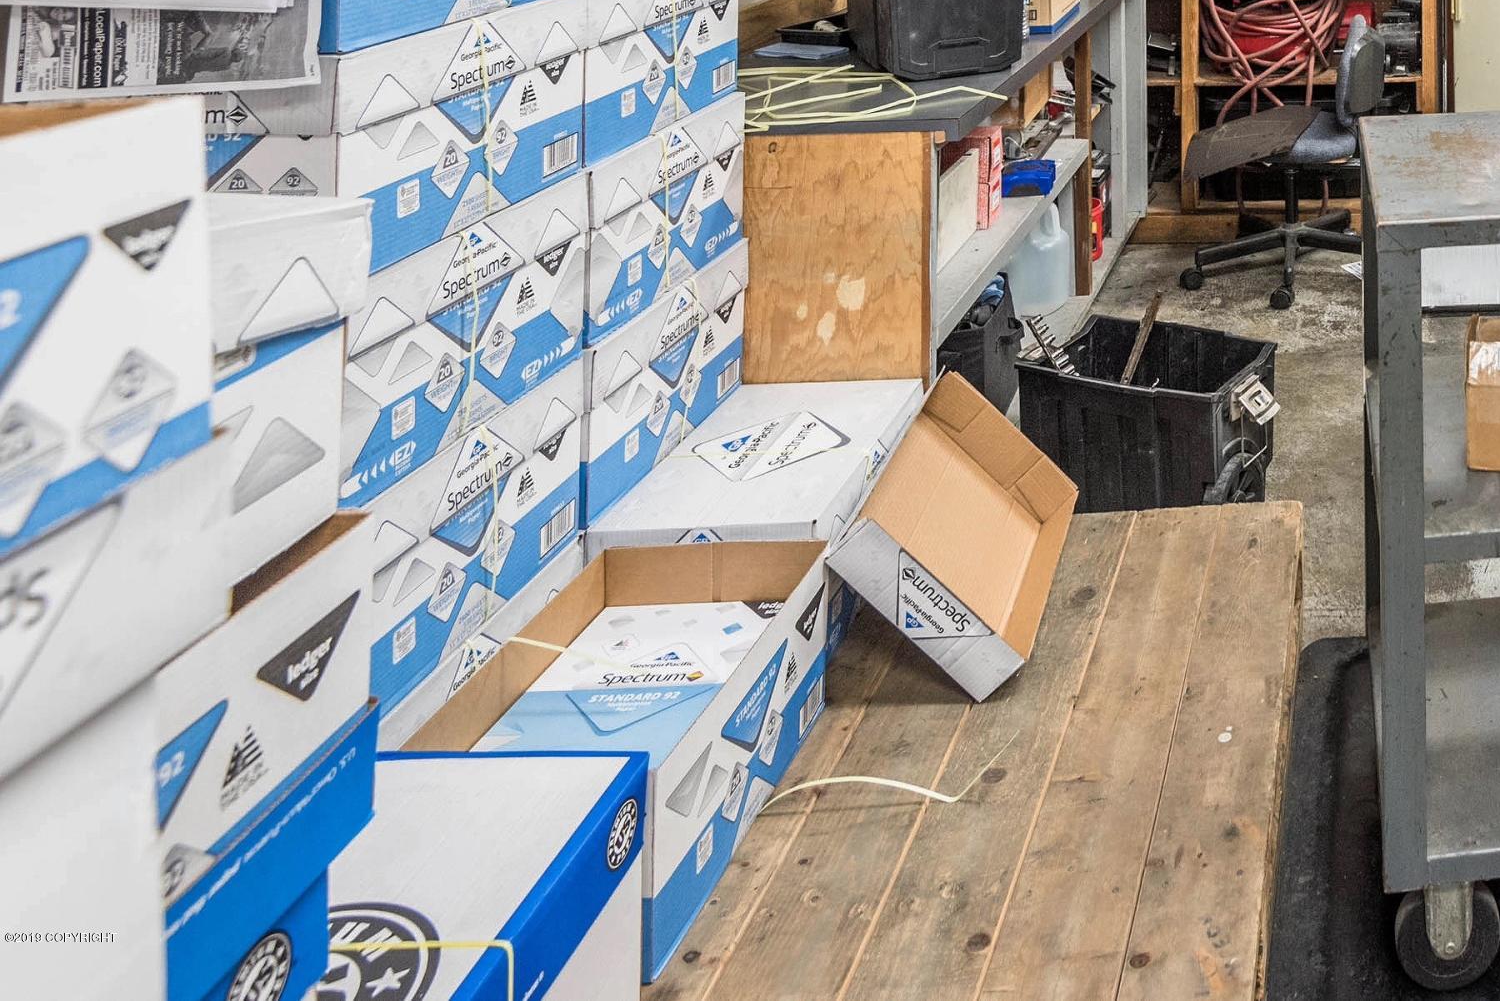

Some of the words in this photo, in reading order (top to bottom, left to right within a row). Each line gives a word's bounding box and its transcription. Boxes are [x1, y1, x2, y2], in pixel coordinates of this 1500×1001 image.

[444, 154, 456, 167] 20
[232, 178, 245, 189] 20
[286, 175, 300, 186] 92
[660, 314, 694, 349] Spectrum
[439, 365, 451, 378] 20
[912, 575, 971, 633] Spectrum
[287, 636, 334, 685] ledger
[598, 673, 686, 686] Spectrum
[588, 692, 661, 703] STANDARD
[664, 691, 681, 701] 92
[157, 750, 187, 788] 92
